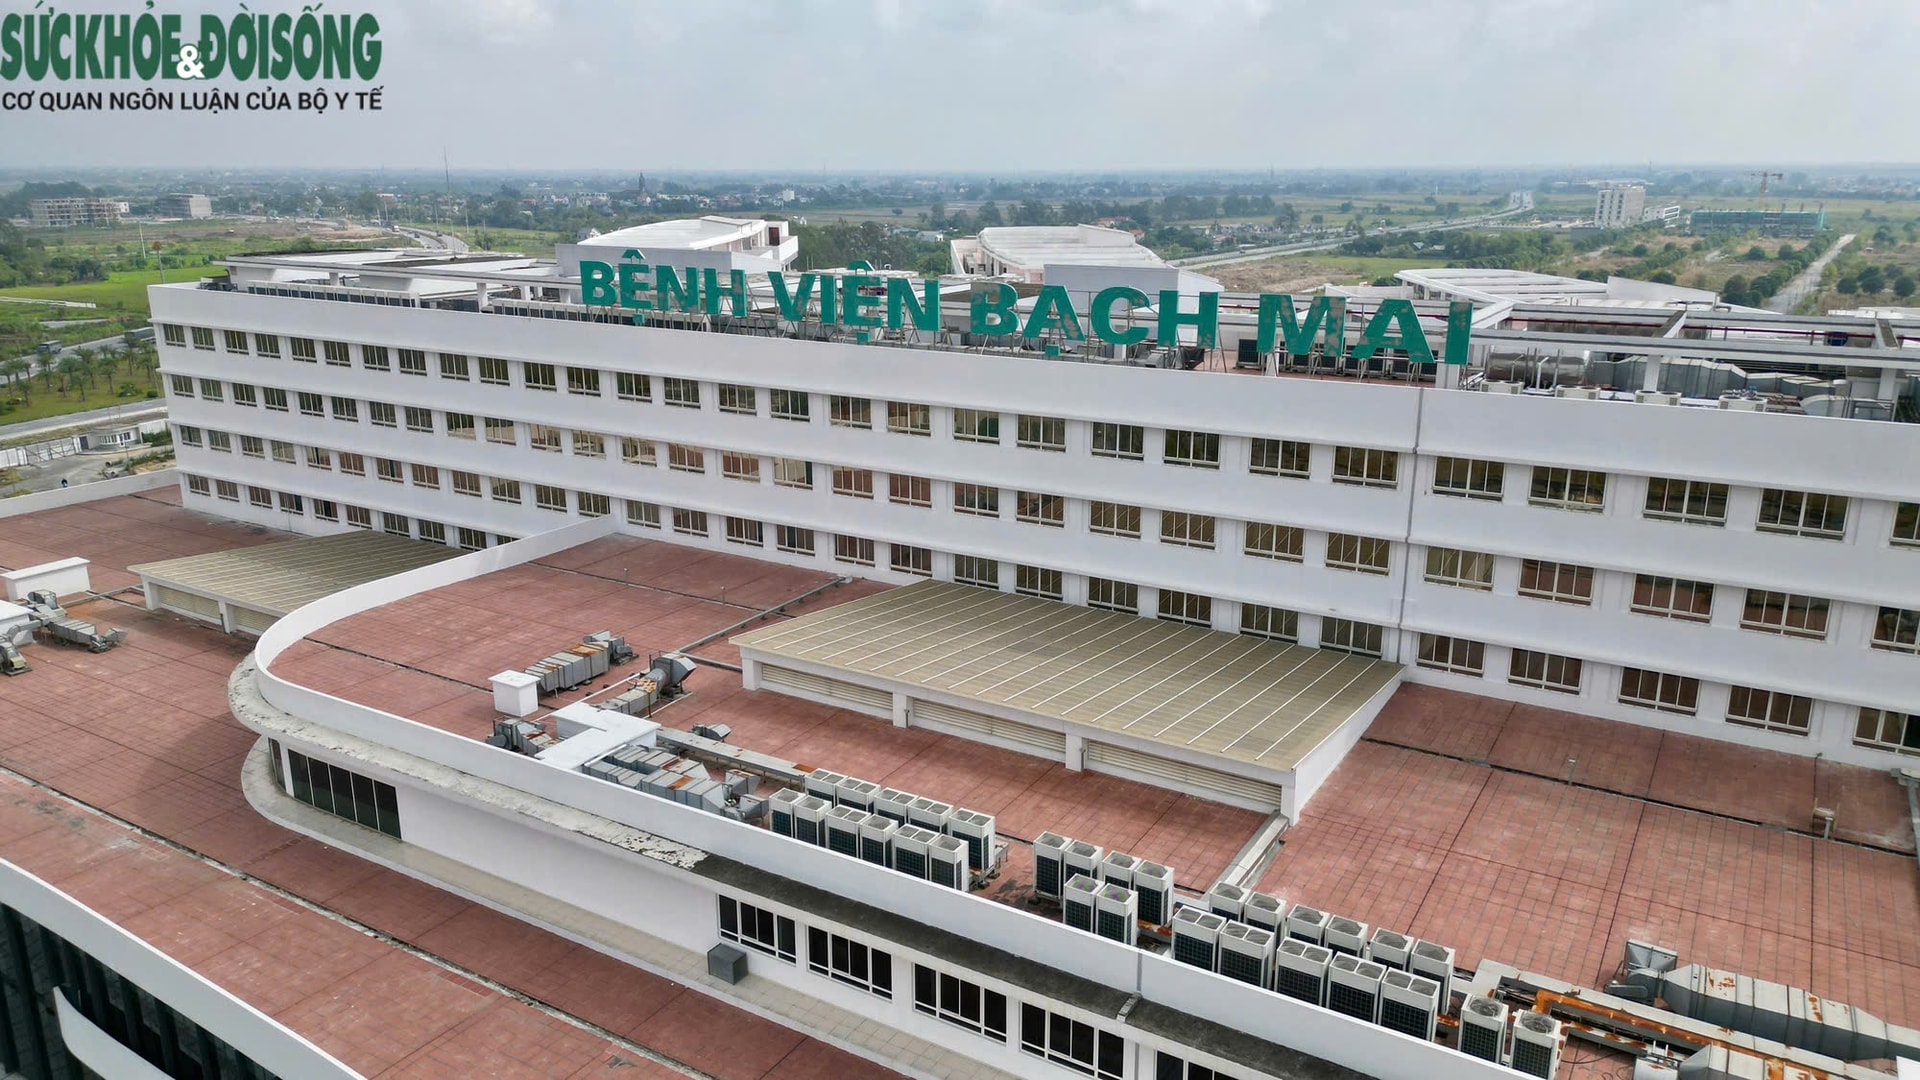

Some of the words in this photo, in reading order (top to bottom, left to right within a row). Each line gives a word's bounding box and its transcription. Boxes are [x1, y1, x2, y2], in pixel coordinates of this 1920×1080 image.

[579, 249, 748, 324] BỆNH
[767, 260, 941, 343] VIỆN
[970, 282, 1220, 357] BẠCH
[1256, 293, 1474, 365] MAI
